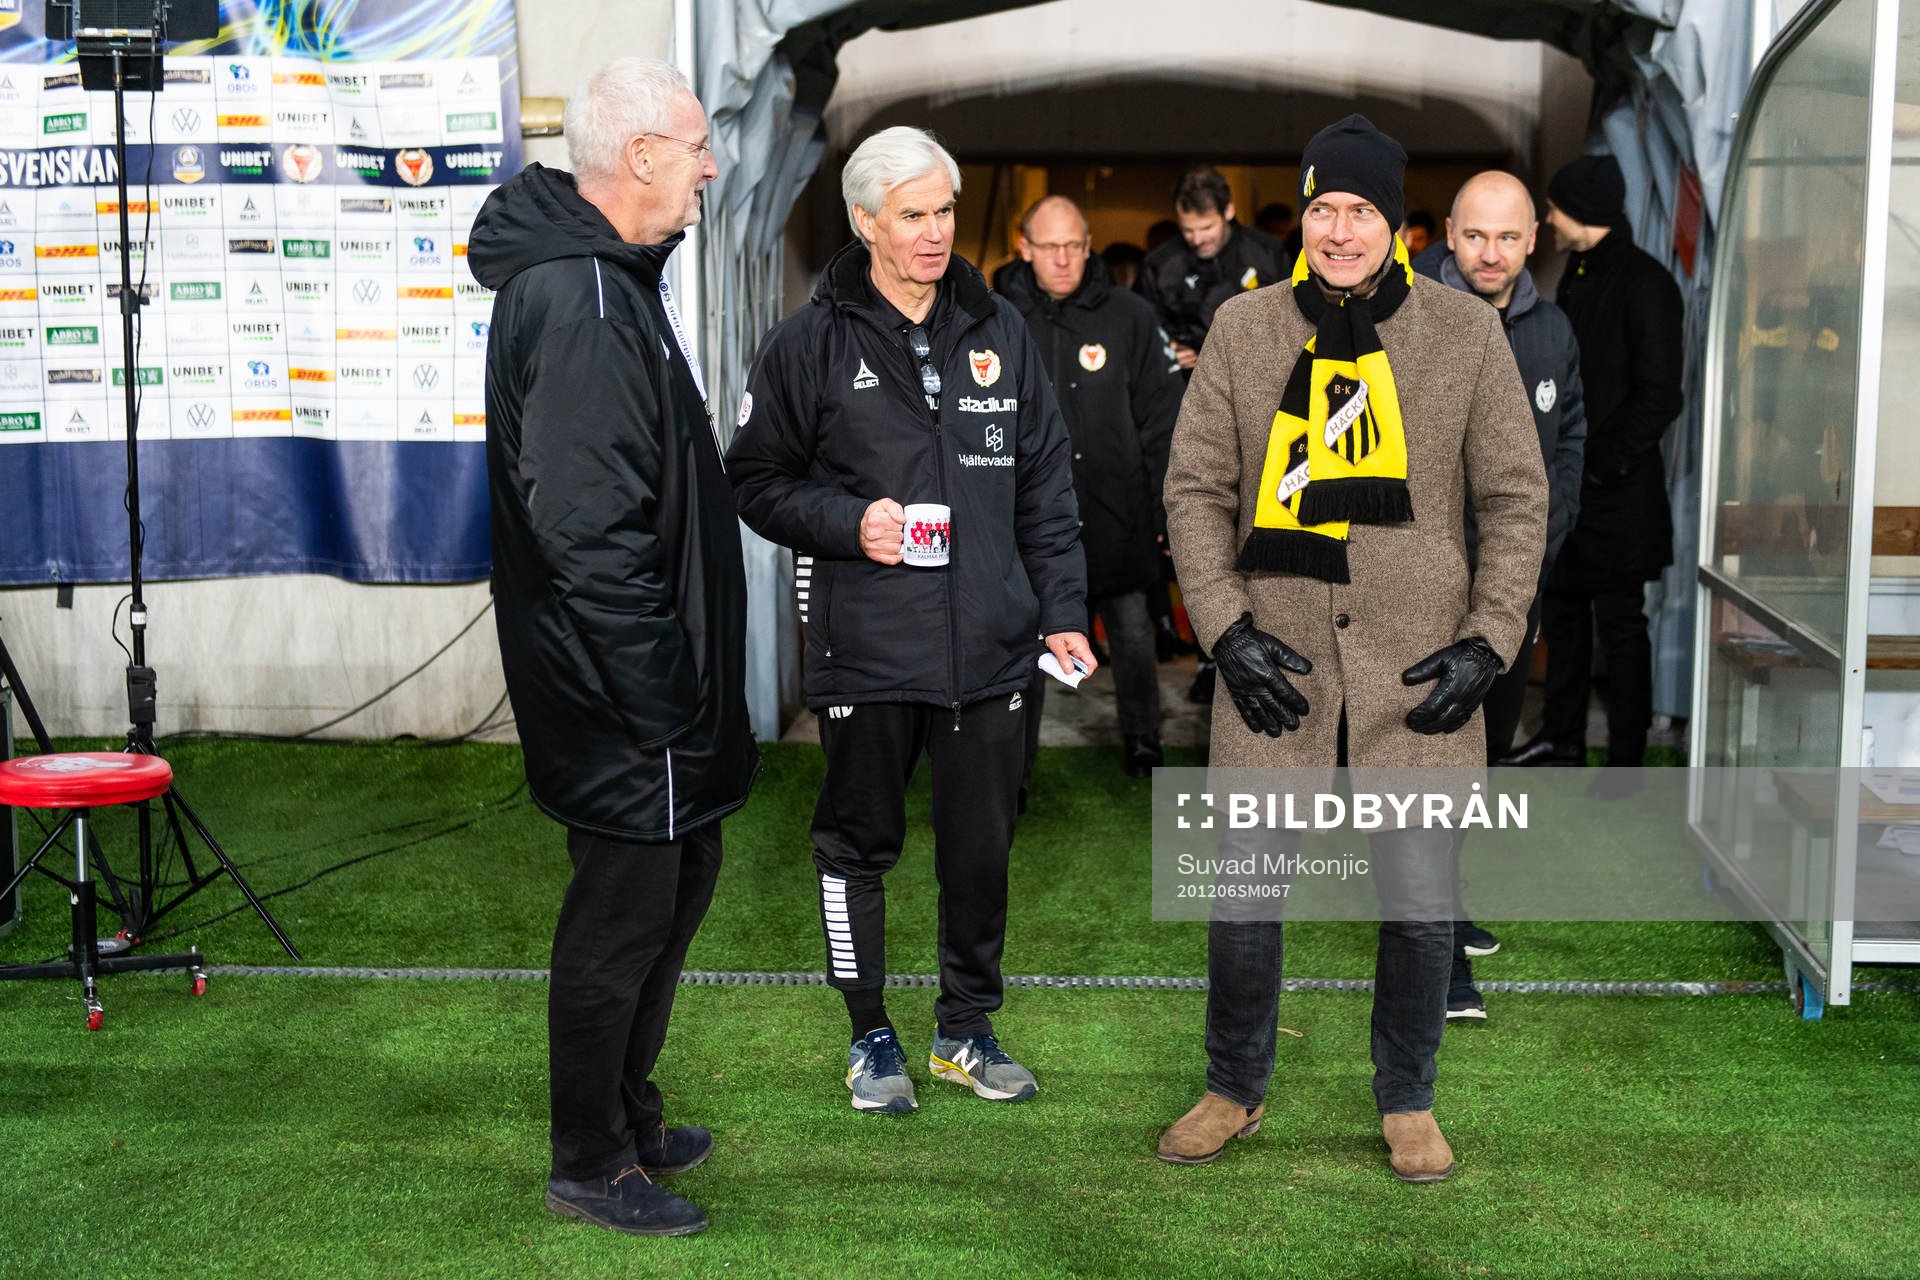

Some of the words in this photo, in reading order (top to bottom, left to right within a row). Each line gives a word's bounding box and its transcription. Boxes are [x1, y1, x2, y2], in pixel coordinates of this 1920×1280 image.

[328, 75, 367, 86] UNIBET
[277, 113, 327, 123] UNIBET
[220, 151, 272, 167] UNIBET
[336, 154, 385, 170] UNIBET
[445, 152, 503, 169] UNIBET
[164, 198, 215, 209] UNIBET
[399, 200, 444, 210] UNIBET
[340, 241, 391, 251] UNIBET
[410, 256, 441, 265] OBOS
[43, 284, 94, 295] UNIBET
[286, 283, 329, 293] UNIBET
[0, 329, 34, 339] IBET
[233, 323, 280, 334] UNIBET
[402, 327, 449, 337] UNIBET
[173, 366, 224, 376] UNIBET
[341, 368, 391, 378] UNIBET
[853, 379, 879, 390] SELECT
[958, 395, 1018, 413] stadium
[296, 407, 330, 419] UNIBET
[1284, 465, 1310, 492] HÄC
